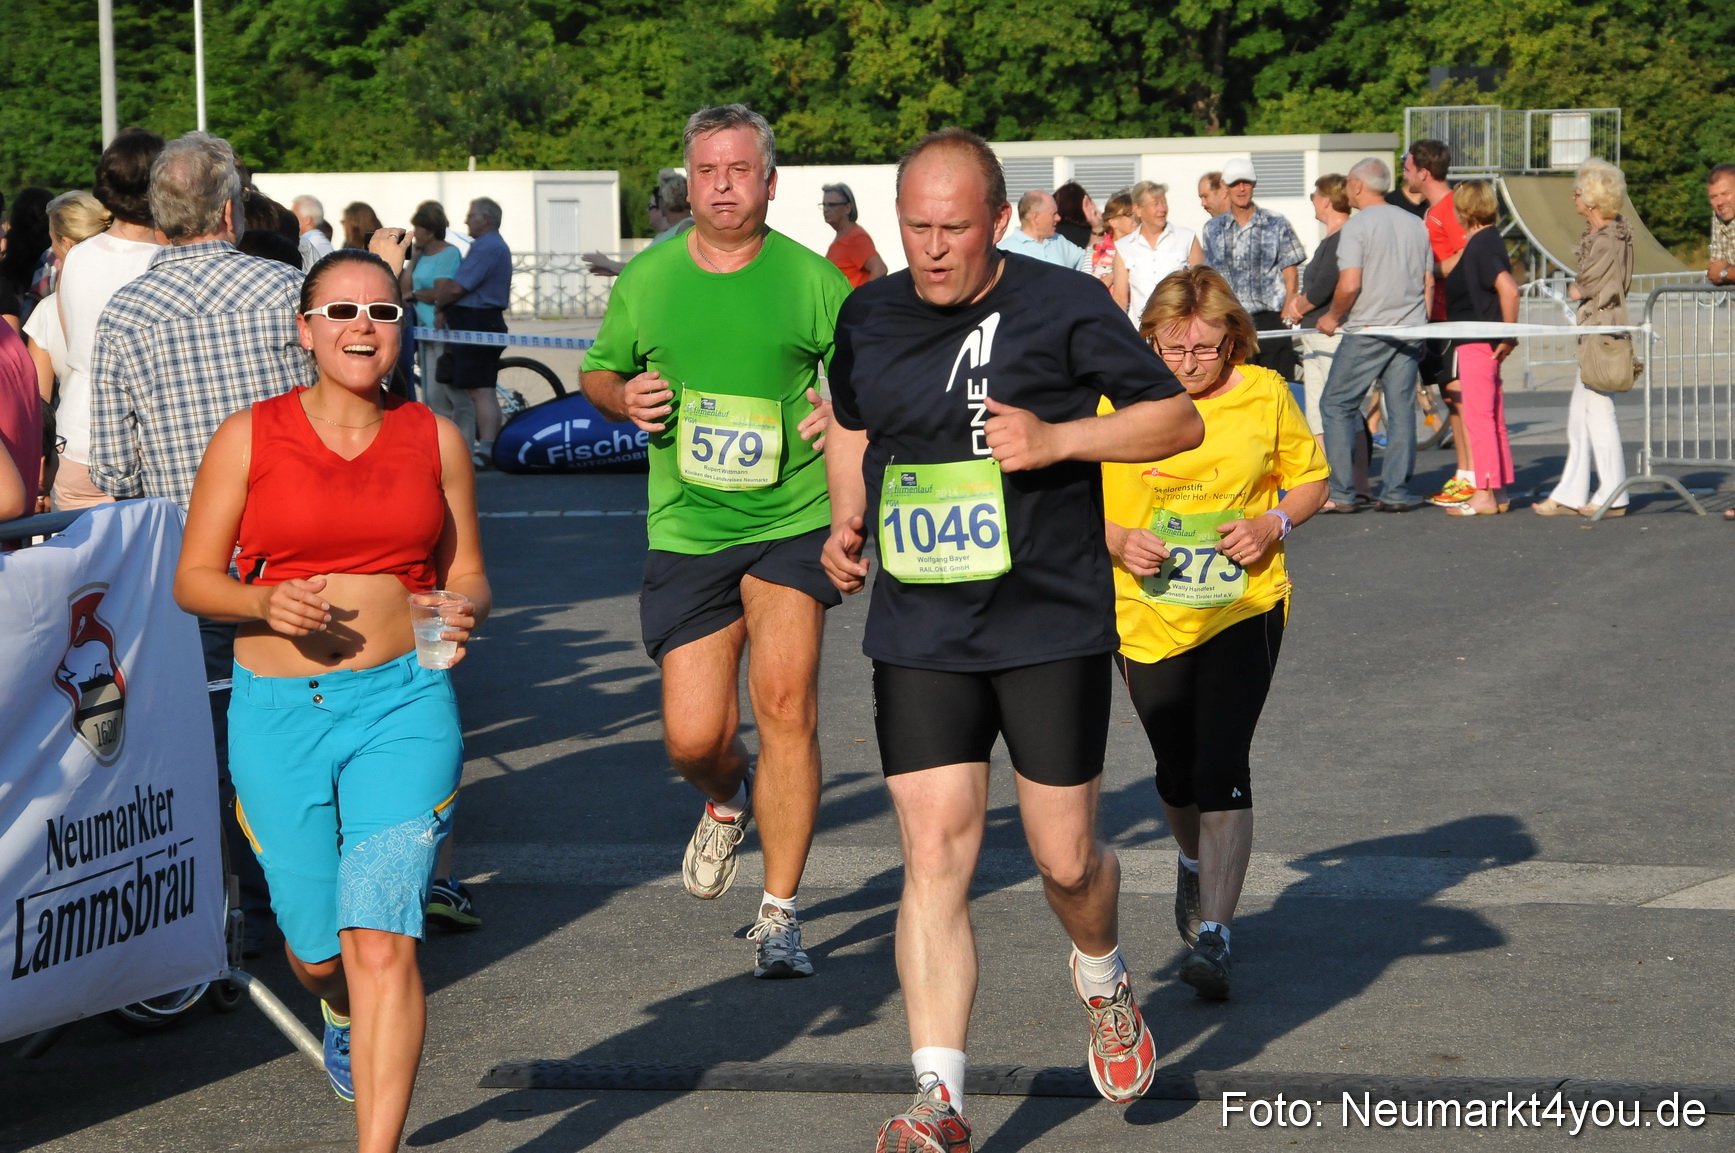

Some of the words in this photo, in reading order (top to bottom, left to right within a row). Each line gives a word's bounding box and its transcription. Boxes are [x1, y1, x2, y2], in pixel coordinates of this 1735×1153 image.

[546, 429, 649, 465] Fische
[692, 425, 764, 467] 579
[567, 450, 648, 469] AUTOMOBI
[684, 469, 703, 477] Kliniken
[704, 464, 722, 474] Rupert
[1154, 483, 1203, 494] Seniorenstift
[1166, 493, 1190, 501] Tiroler
[1192, 492, 1207, 501] Hof
[884, 502, 1001, 554] 1046
[917, 556, 948, 564] Wolfgang
[1172, 583, 1188, 592] Wally
[45, 784, 174, 875] Neumarkter
[11, 842, 196, 981] Lammsbräu
